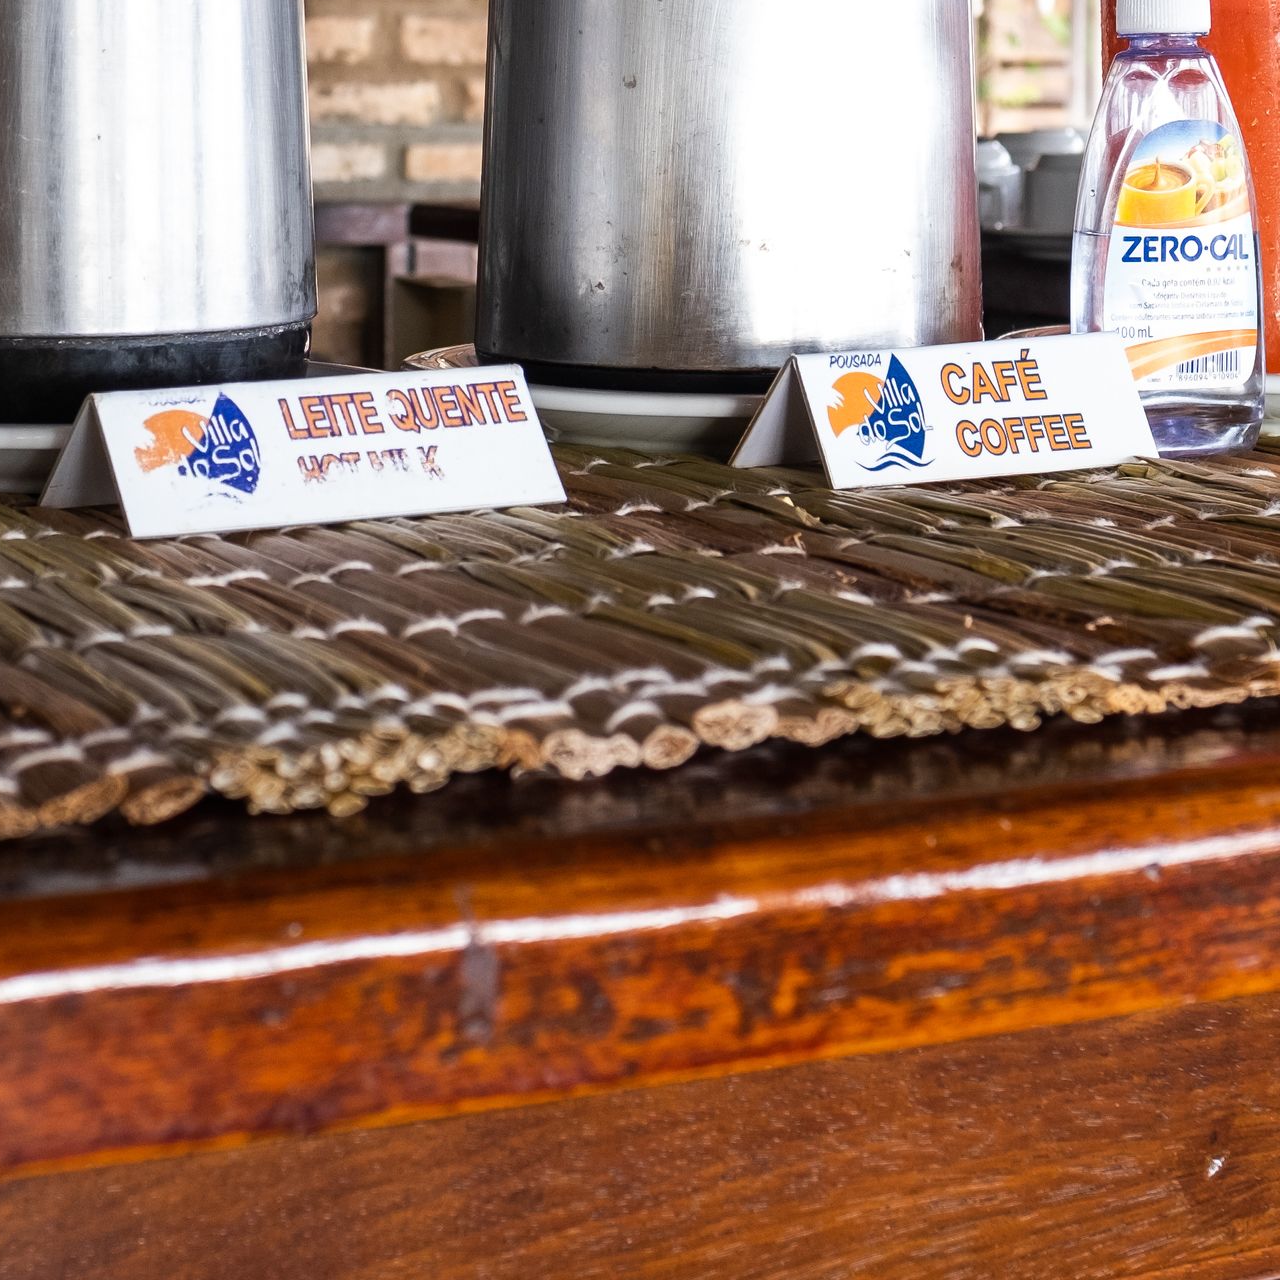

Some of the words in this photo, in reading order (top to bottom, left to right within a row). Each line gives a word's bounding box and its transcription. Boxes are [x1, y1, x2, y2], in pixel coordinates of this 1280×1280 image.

[1137, 325, 1154, 339] mL
[829, 353, 882, 369] POUSADA
[940, 348, 1048, 406] CAFÉ
[277, 391, 385, 440] LEITE
[385, 380, 528, 434] QUENTE
[863, 377, 916, 415] Villa
[181, 413, 250, 454] Villa
[857, 414, 887, 446] do
[885, 401, 934, 451] Sol
[955, 412, 1093, 458] COFFEE
